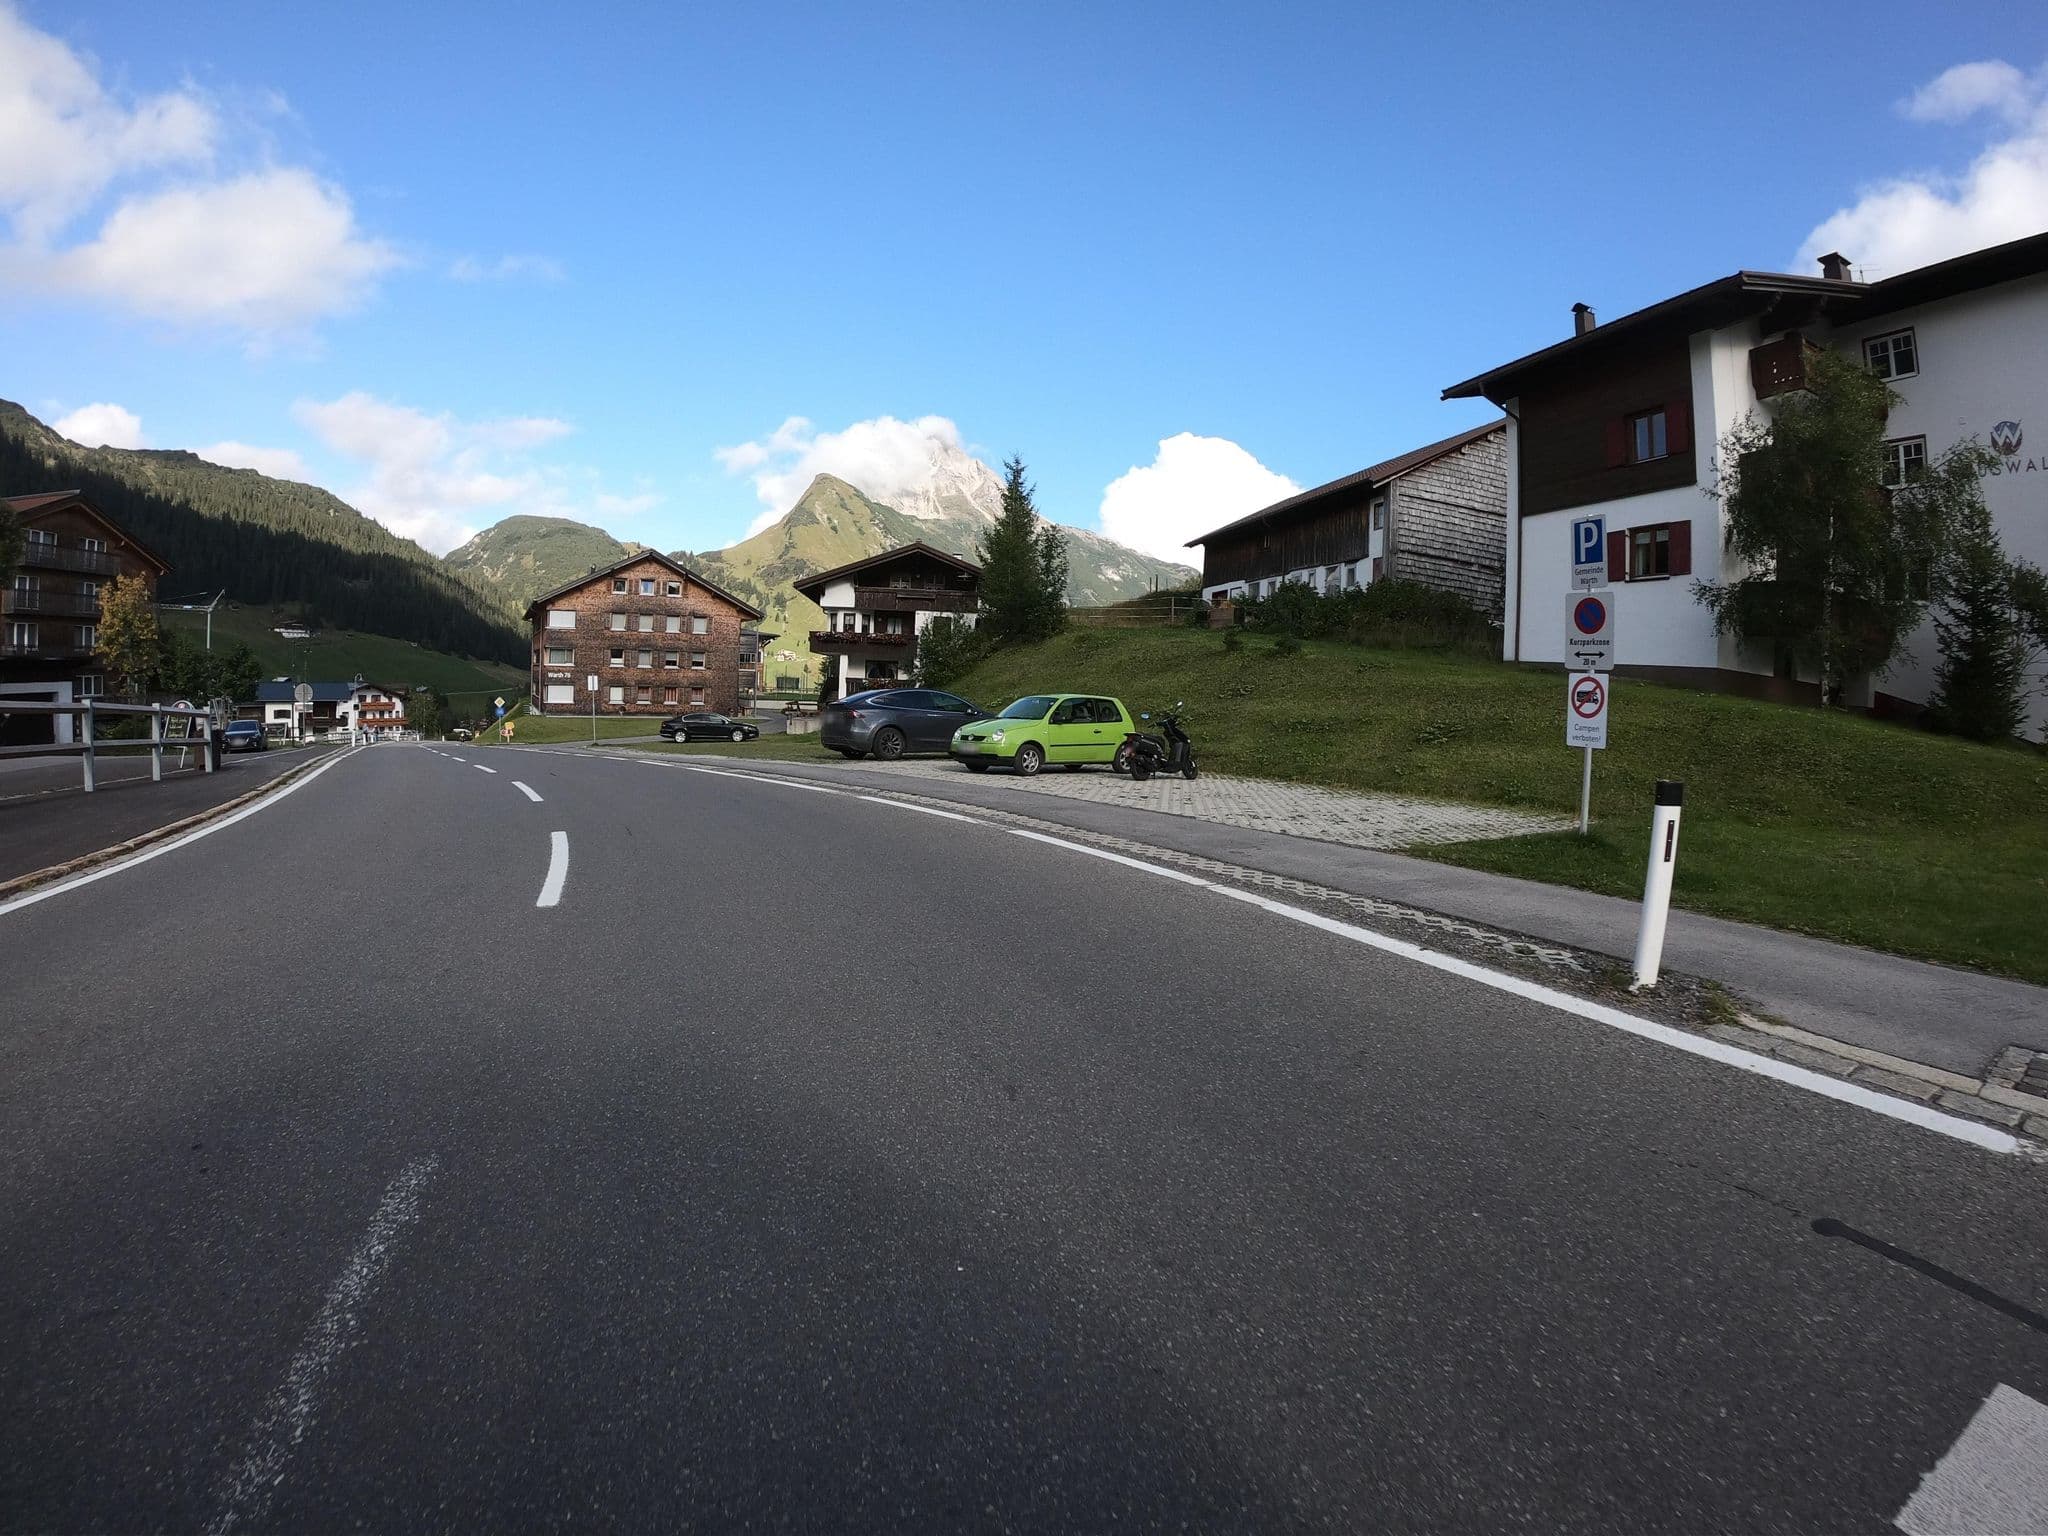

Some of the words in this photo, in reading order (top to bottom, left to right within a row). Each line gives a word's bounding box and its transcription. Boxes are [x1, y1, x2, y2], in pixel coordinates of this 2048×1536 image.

[1580, 522, 1598, 562] P
[1575, 566, 1603, 576] Gemeinde
[1569, 638, 1610, 647] Kurzparkzone
[1574, 723, 1600, 733] Campen
